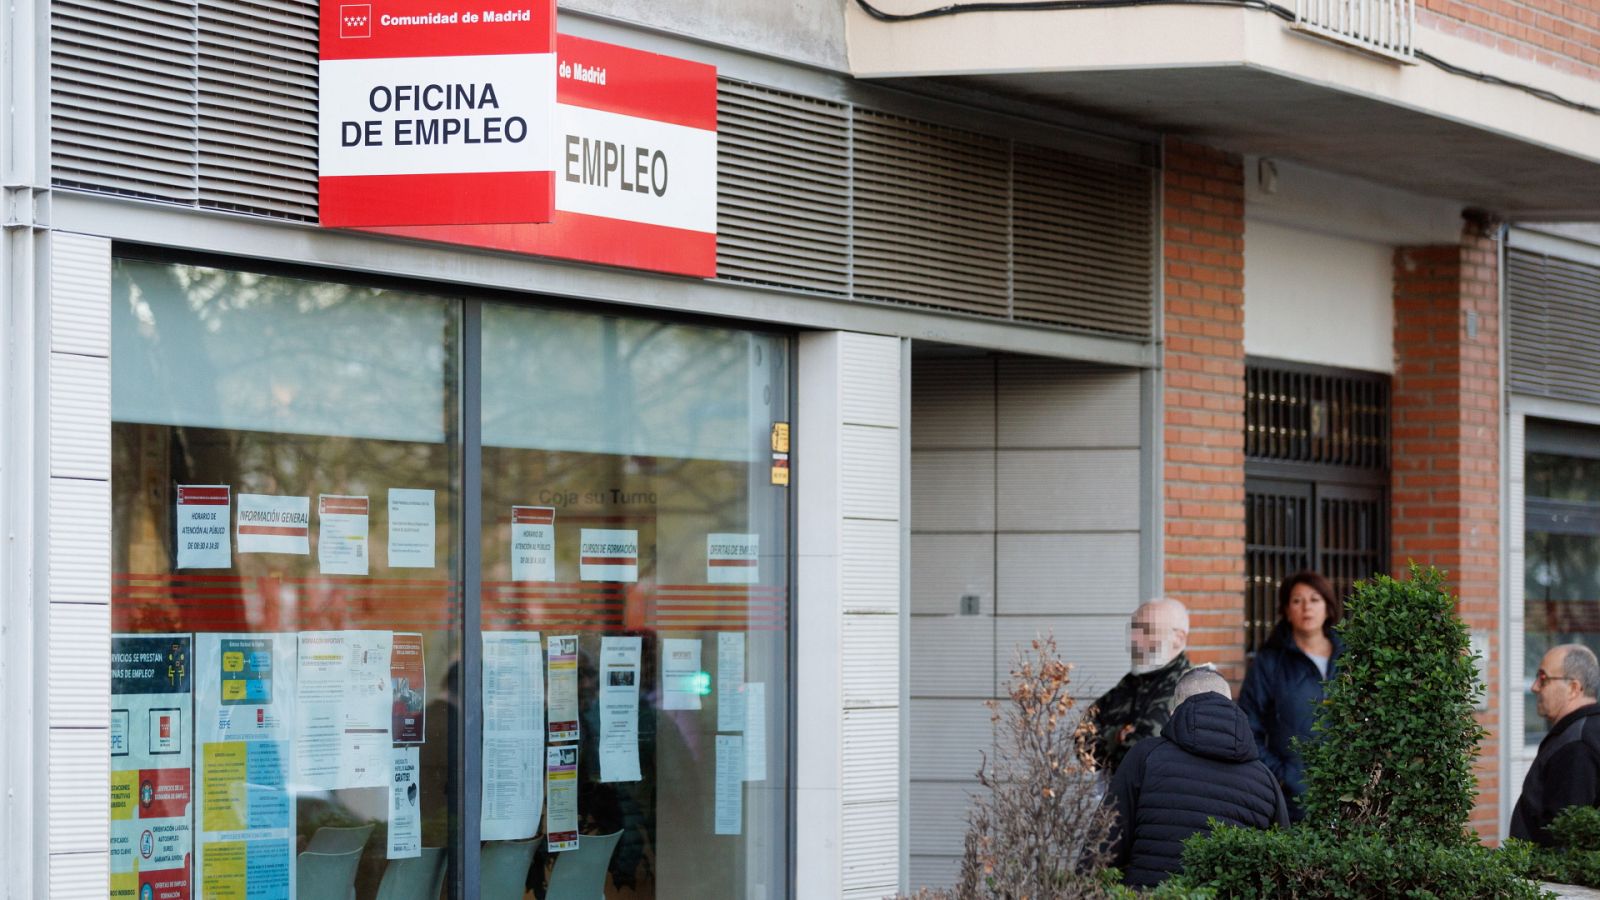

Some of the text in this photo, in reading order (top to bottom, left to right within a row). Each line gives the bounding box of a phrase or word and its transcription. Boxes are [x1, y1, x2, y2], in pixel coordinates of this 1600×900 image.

[380, 9, 531, 26] Comunidad de Madrid
[558, 60, 607, 86] de Madrid
[369, 82, 500, 113] OFICINA
[341, 116, 528, 147] DE EMPLEO
[565, 134, 668, 198] EMPLEO
[539, 489, 580, 507] Coja
[584, 491, 604, 505] su
[191, 512, 217, 520] HORARIO DE
[240, 509, 308, 524] INFORMACIÓN GENERAL
[607, 541, 638, 554] FORMACIÓN
[133, 653, 139, 663] SE
[140, 652, 163, 663] PRESTAN
[125, 669, 131, 678] DE
[132, 669, 155, 679] EMPLEO?
